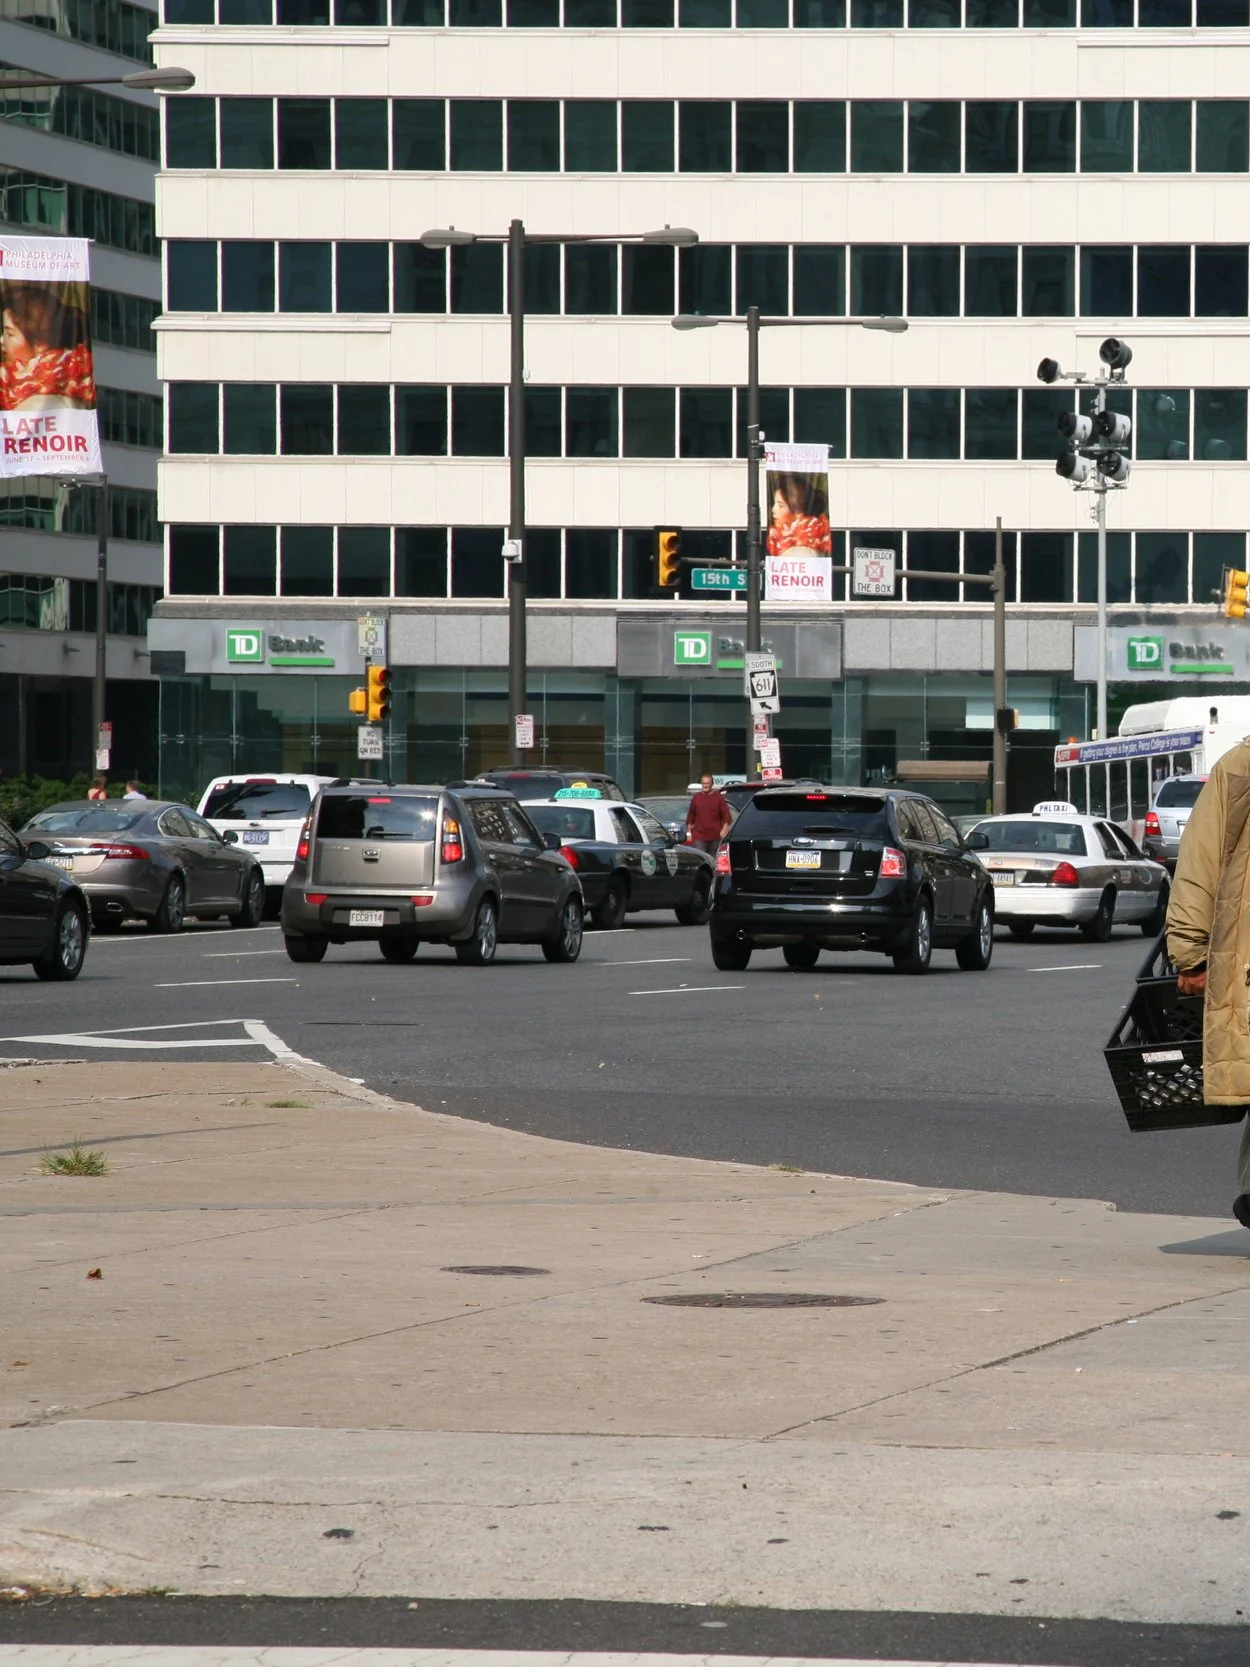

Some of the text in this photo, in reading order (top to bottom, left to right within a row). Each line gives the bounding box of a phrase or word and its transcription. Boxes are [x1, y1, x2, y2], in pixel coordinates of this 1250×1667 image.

[6, 250, 72, 259] PHILADELPHIA
[5, 260, 80, 269] MUSEUM OF ART
[2, 416, 57, 435] LATE
[4, 435, 88, 455] RENOIR
[874, 551, 892, 560] BLOCK
[771, 561, 806, 573] LATE
[702, 573, 747, 586] 15th S
[771, 574, 824, 587] RENOIR
[857, 582, 891, 593] THE BOX
[229, 634, 325, 655] TD Bank
[678, 637, 773, 658] TD Bak
[1130, 641, 1224, 662] TD Bank
[751, 661, 773, 670] SOUTH
[756, 679, 771, 692] 611
[1039, 804, 1068, 812] PHL TAXI
